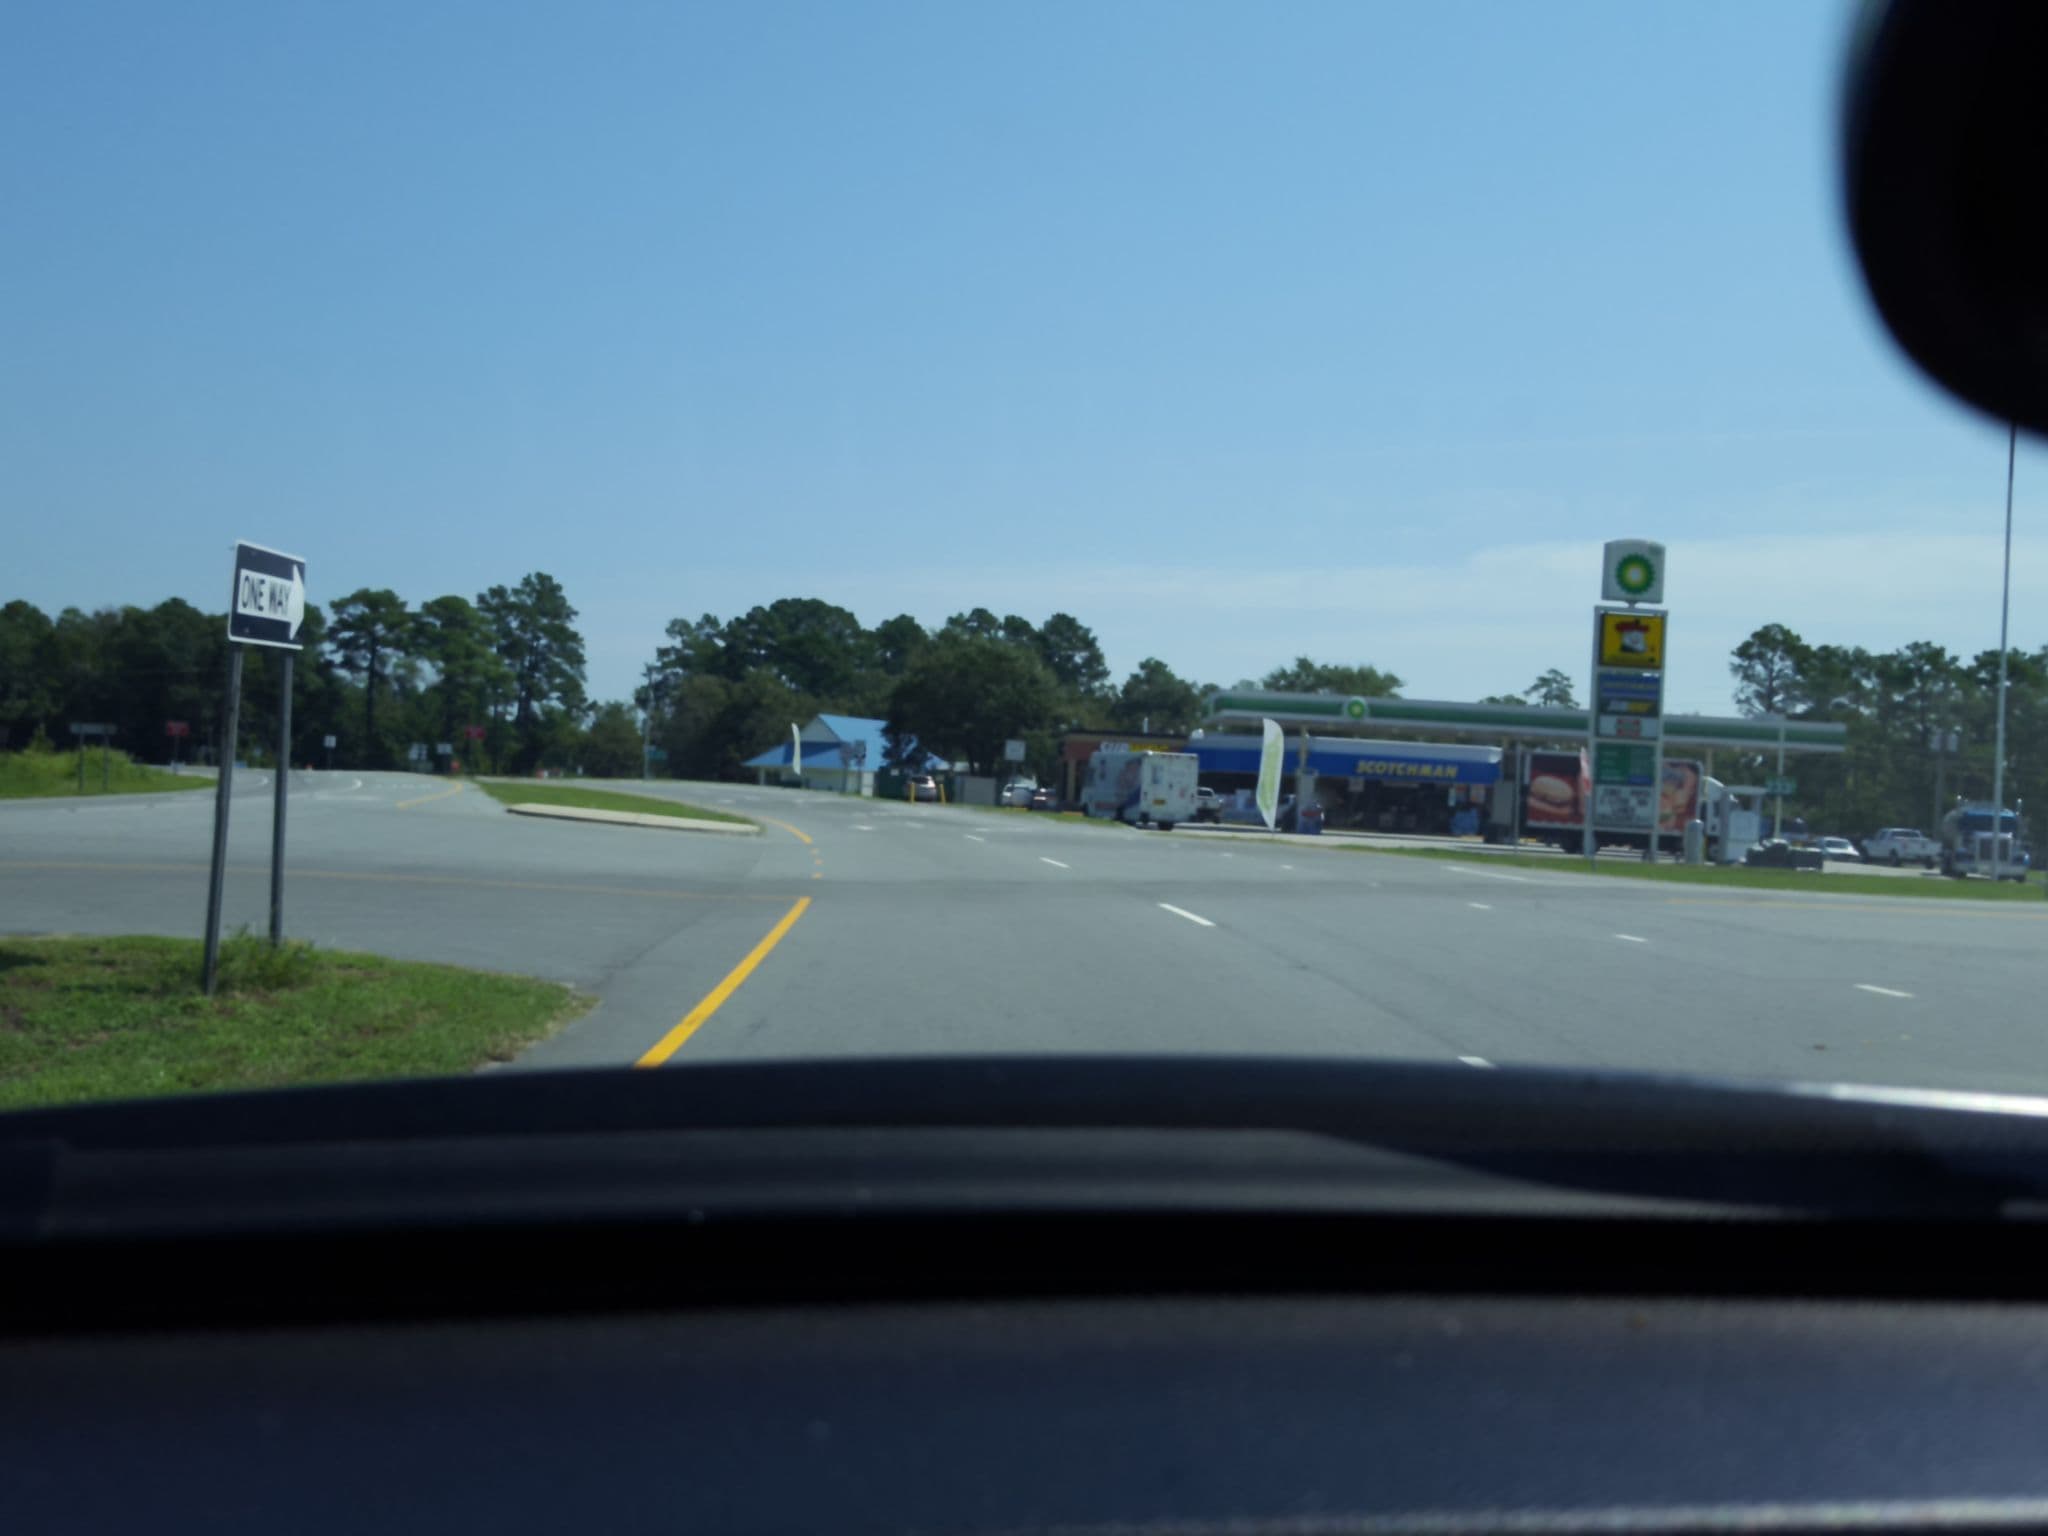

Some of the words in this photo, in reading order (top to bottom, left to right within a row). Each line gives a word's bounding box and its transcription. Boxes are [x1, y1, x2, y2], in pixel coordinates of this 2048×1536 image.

[241, 575, 266, 612] ONE
[268, 580, 291, 616] WAY
[1356, 759, 1459, 778] SCOTCHMAN
